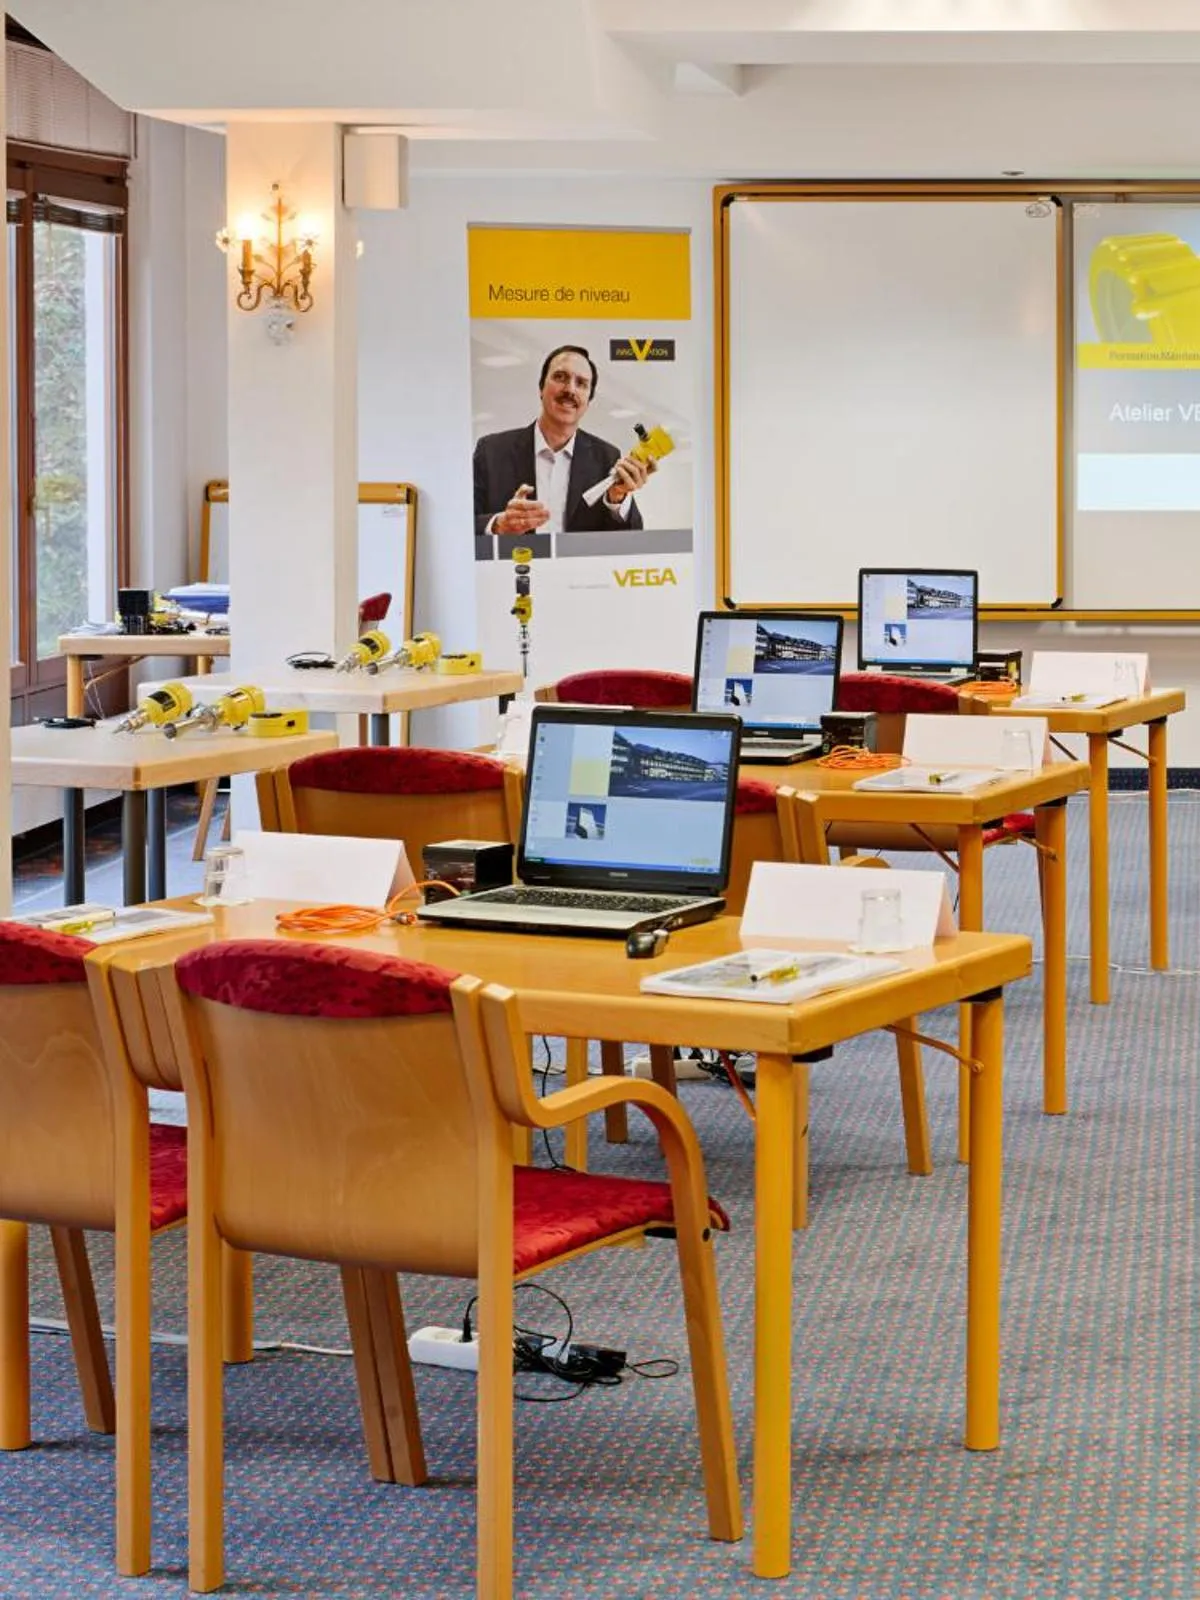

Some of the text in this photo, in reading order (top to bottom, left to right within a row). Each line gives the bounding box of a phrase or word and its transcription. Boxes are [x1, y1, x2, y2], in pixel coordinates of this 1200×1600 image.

[488, 283, 631, 303] Mesure de niveau
[1109, 401, 1173, 422] Atelier
[612, 567, 677, 587] VEGA
